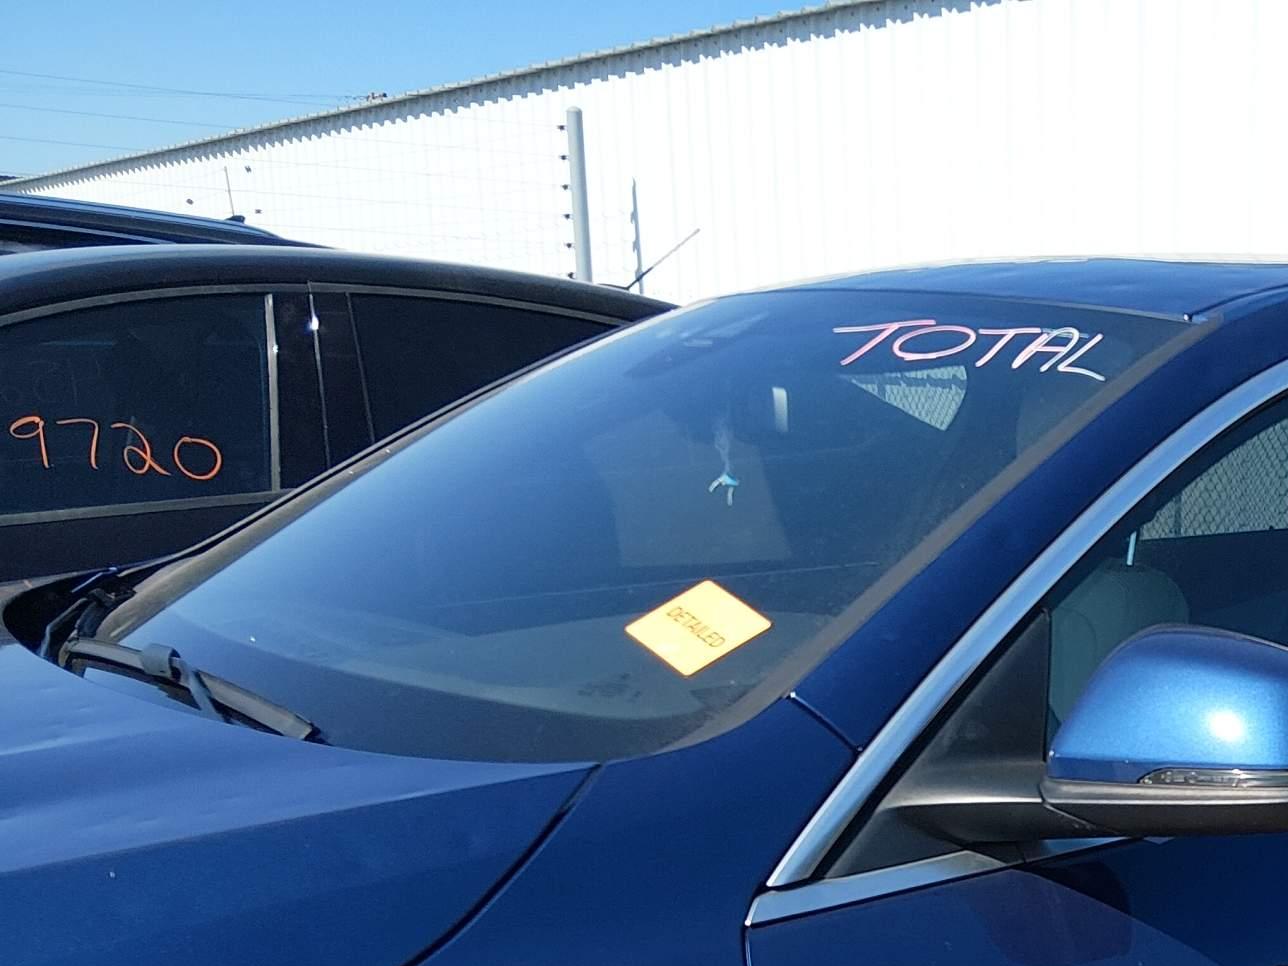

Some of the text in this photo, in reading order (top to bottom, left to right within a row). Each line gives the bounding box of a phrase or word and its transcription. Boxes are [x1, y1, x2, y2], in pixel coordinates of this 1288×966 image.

[832, 319, 1106, 382] TOTAL
[9, 415, 223, 481] 9720
[666, 605, 726, 648] DETAILED
